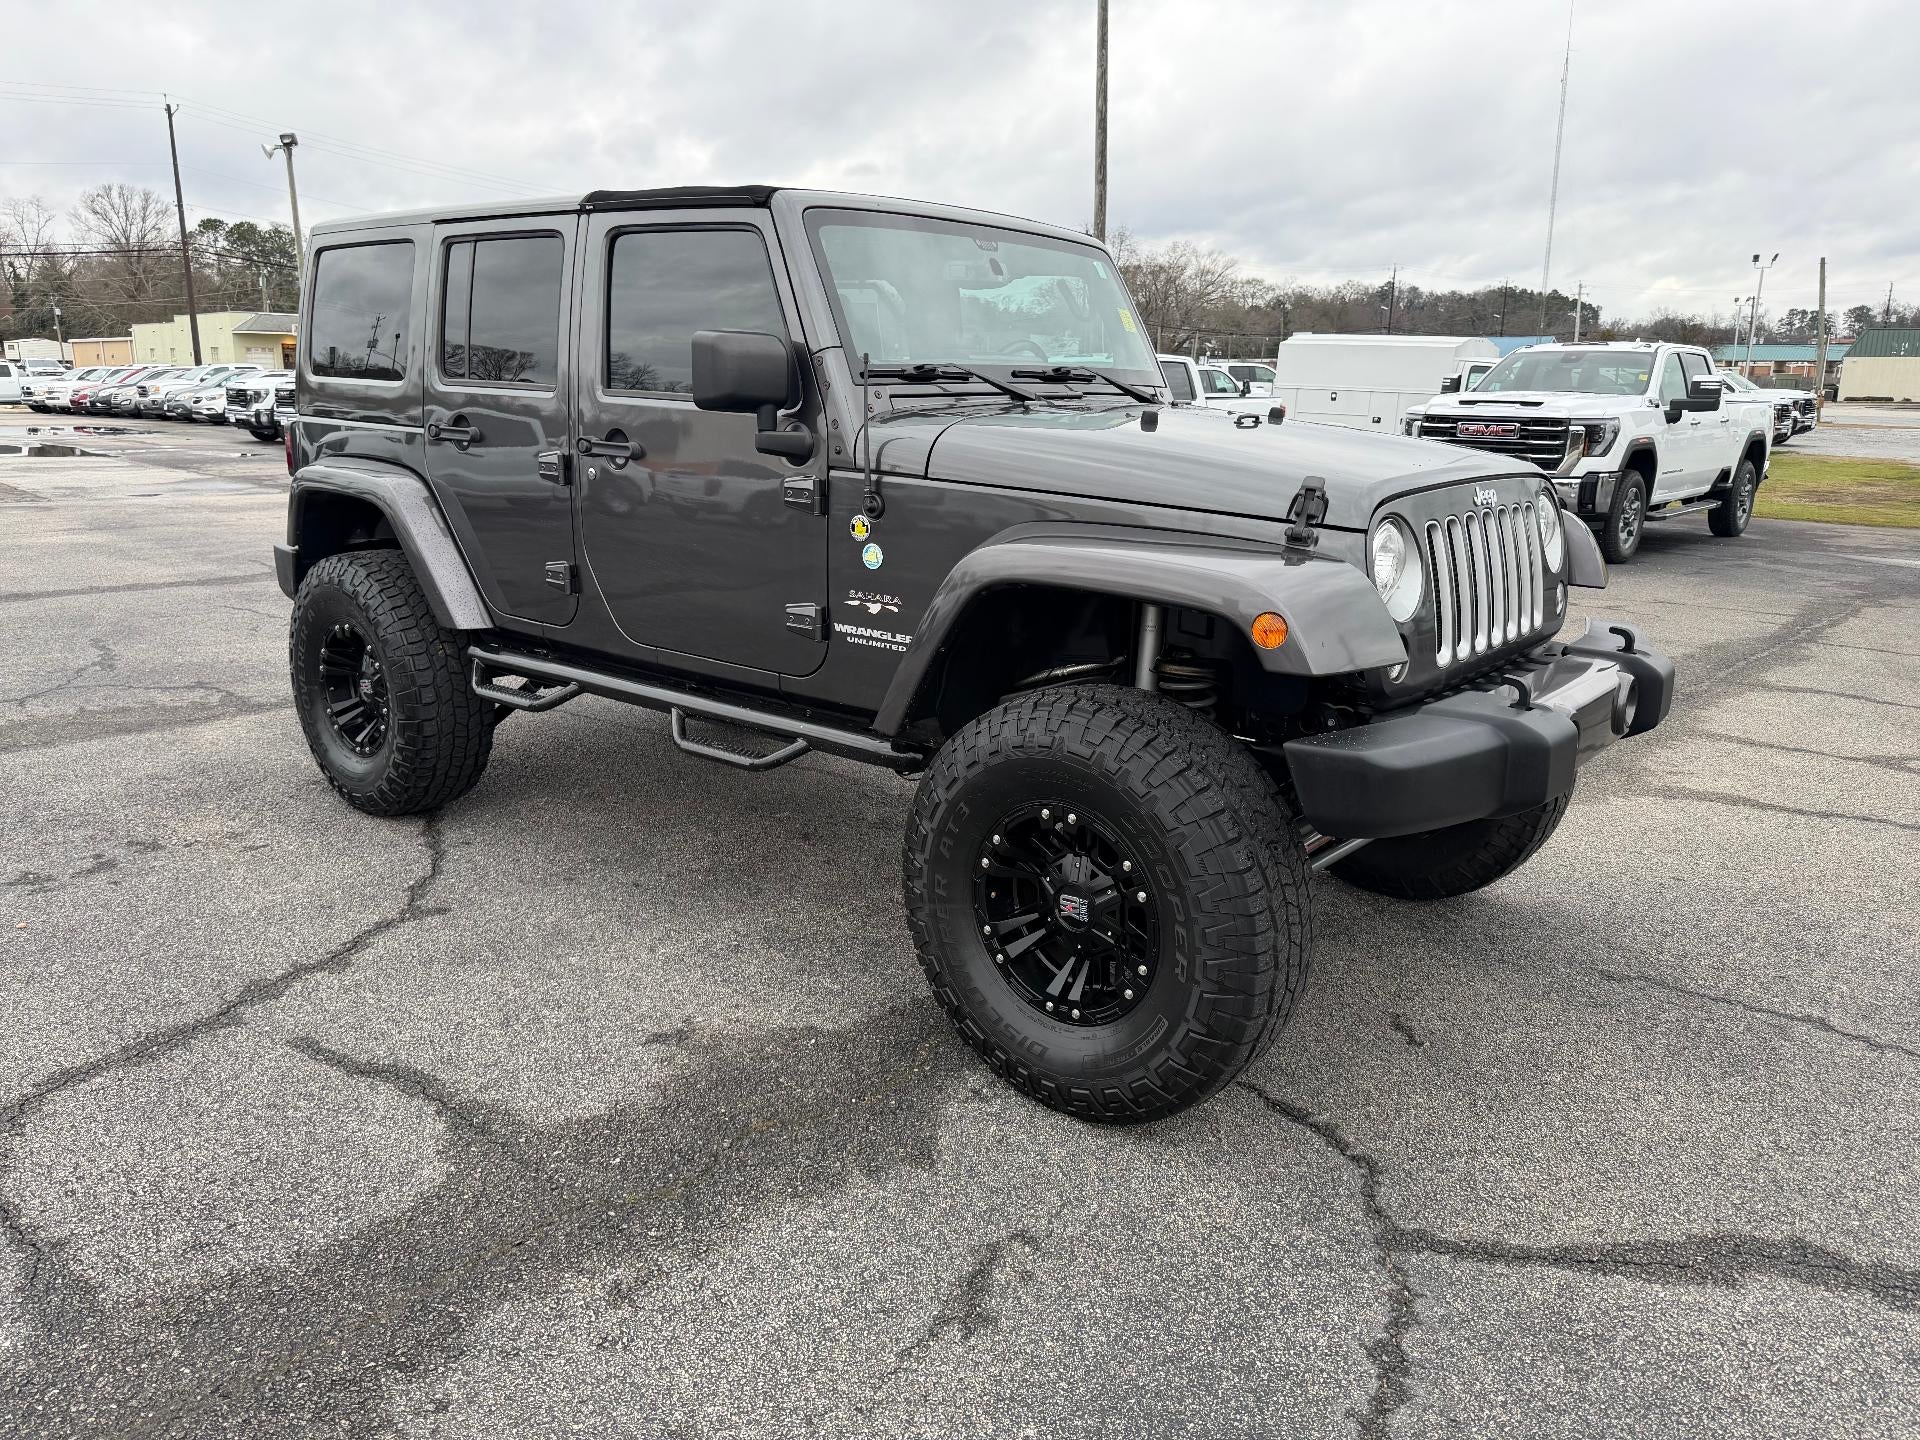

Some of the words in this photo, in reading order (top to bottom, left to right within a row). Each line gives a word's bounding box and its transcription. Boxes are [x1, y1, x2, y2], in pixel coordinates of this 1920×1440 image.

[1460, 425, 1517, 437] GMC
[1473, 487, 1497, 507] Jeep
[848, 590, 902, 605] SAHARA
[846, 636, 907, 652] UNLIMITED
[1119, 812, 1189, 984] COOPER
[1079, 898, 1089, 923] SERIES
